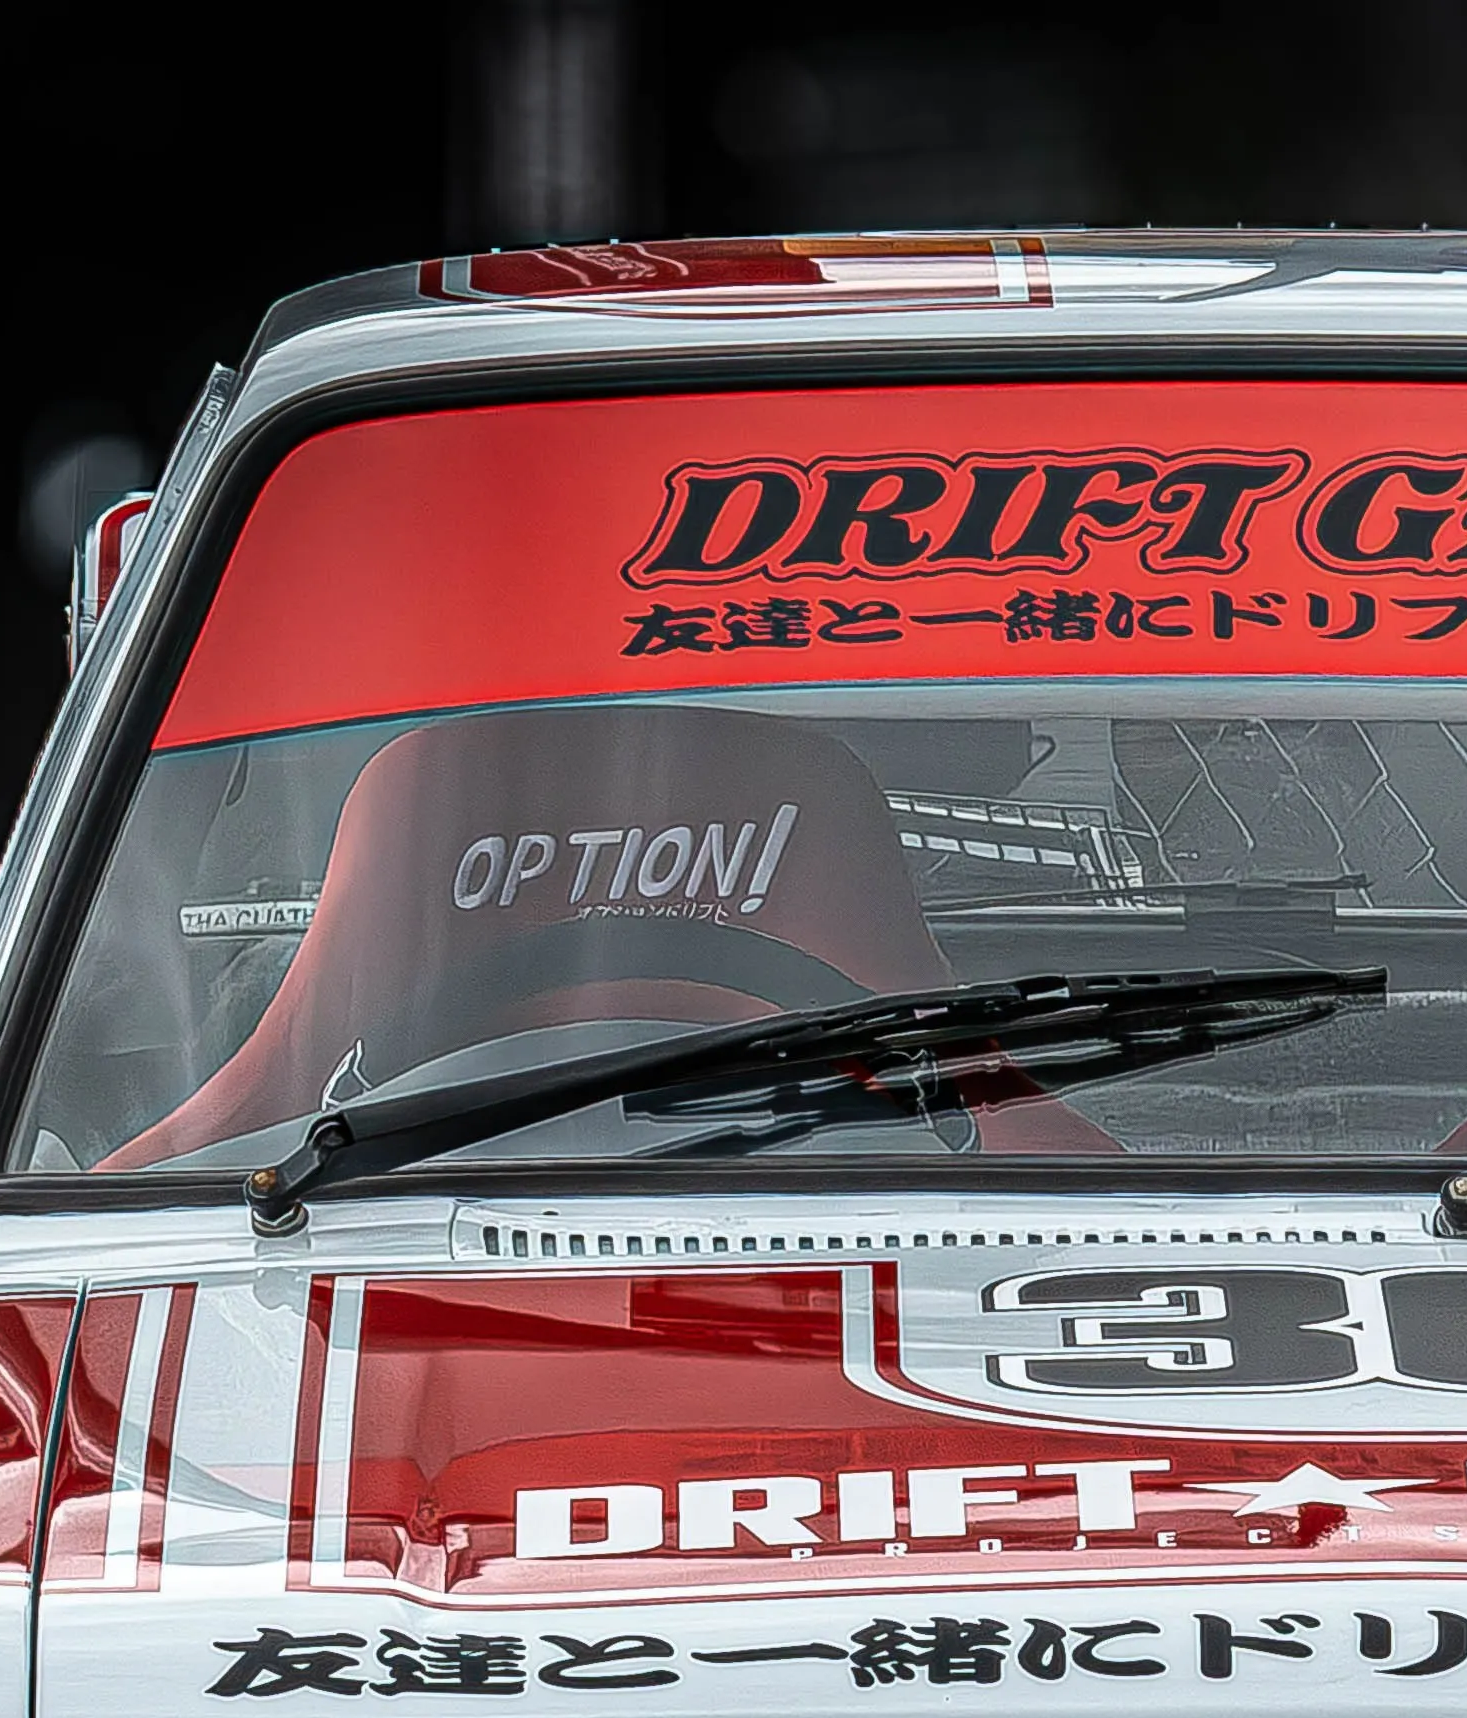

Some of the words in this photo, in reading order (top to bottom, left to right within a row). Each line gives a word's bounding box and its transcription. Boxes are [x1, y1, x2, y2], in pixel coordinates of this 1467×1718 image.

[621, 448, 1311, 588] DRIFT
[454, 803, 798, 913] OPTION!
[515, 1458, 1171, 1560] DRIFT
